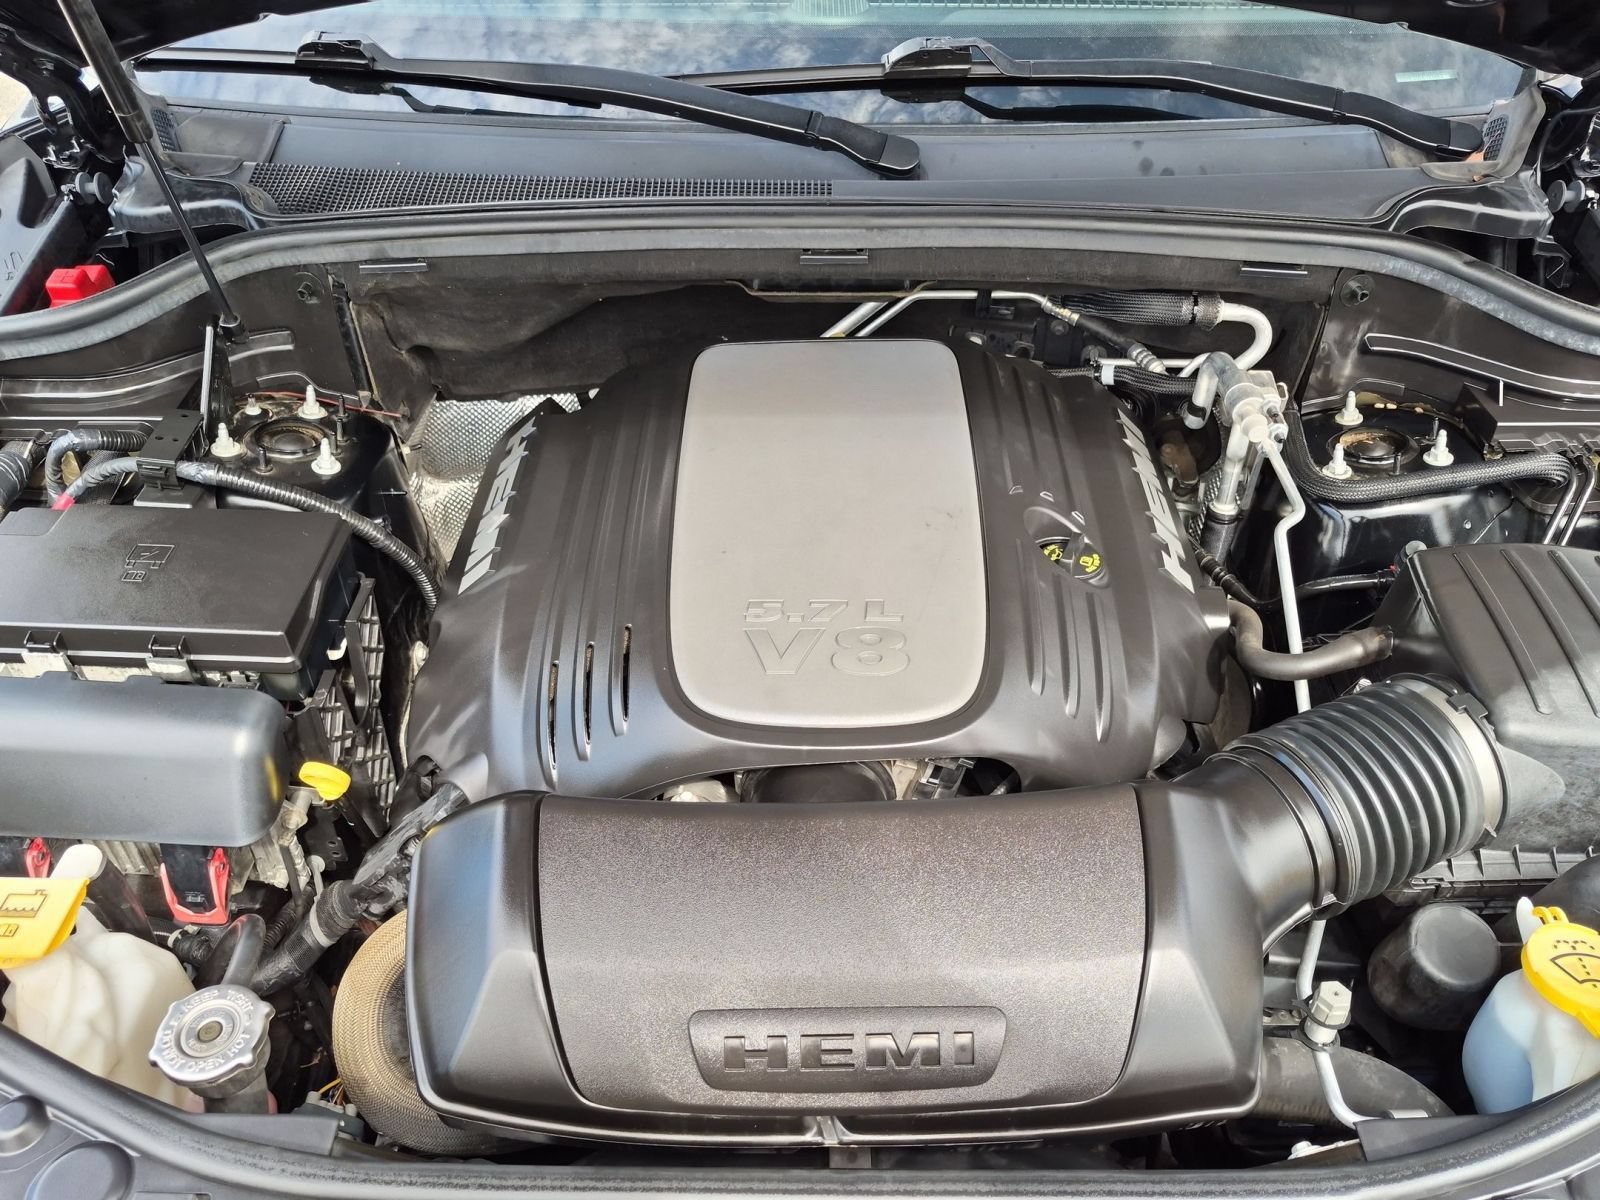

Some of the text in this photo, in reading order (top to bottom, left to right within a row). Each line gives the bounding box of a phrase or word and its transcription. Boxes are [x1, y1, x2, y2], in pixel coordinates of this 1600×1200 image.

[458, 416, 537, 595] HEMI
[1116, 408, 1195, 594] HEMI
[743, 626, 910, 676] V8
[183, 990, 218, 1012] KEEP
[187, 1056, 225, 1073] OPEN
[227, 1033, 251, 1057] HOT
[723, 1031, 975, 1072] HEMI
